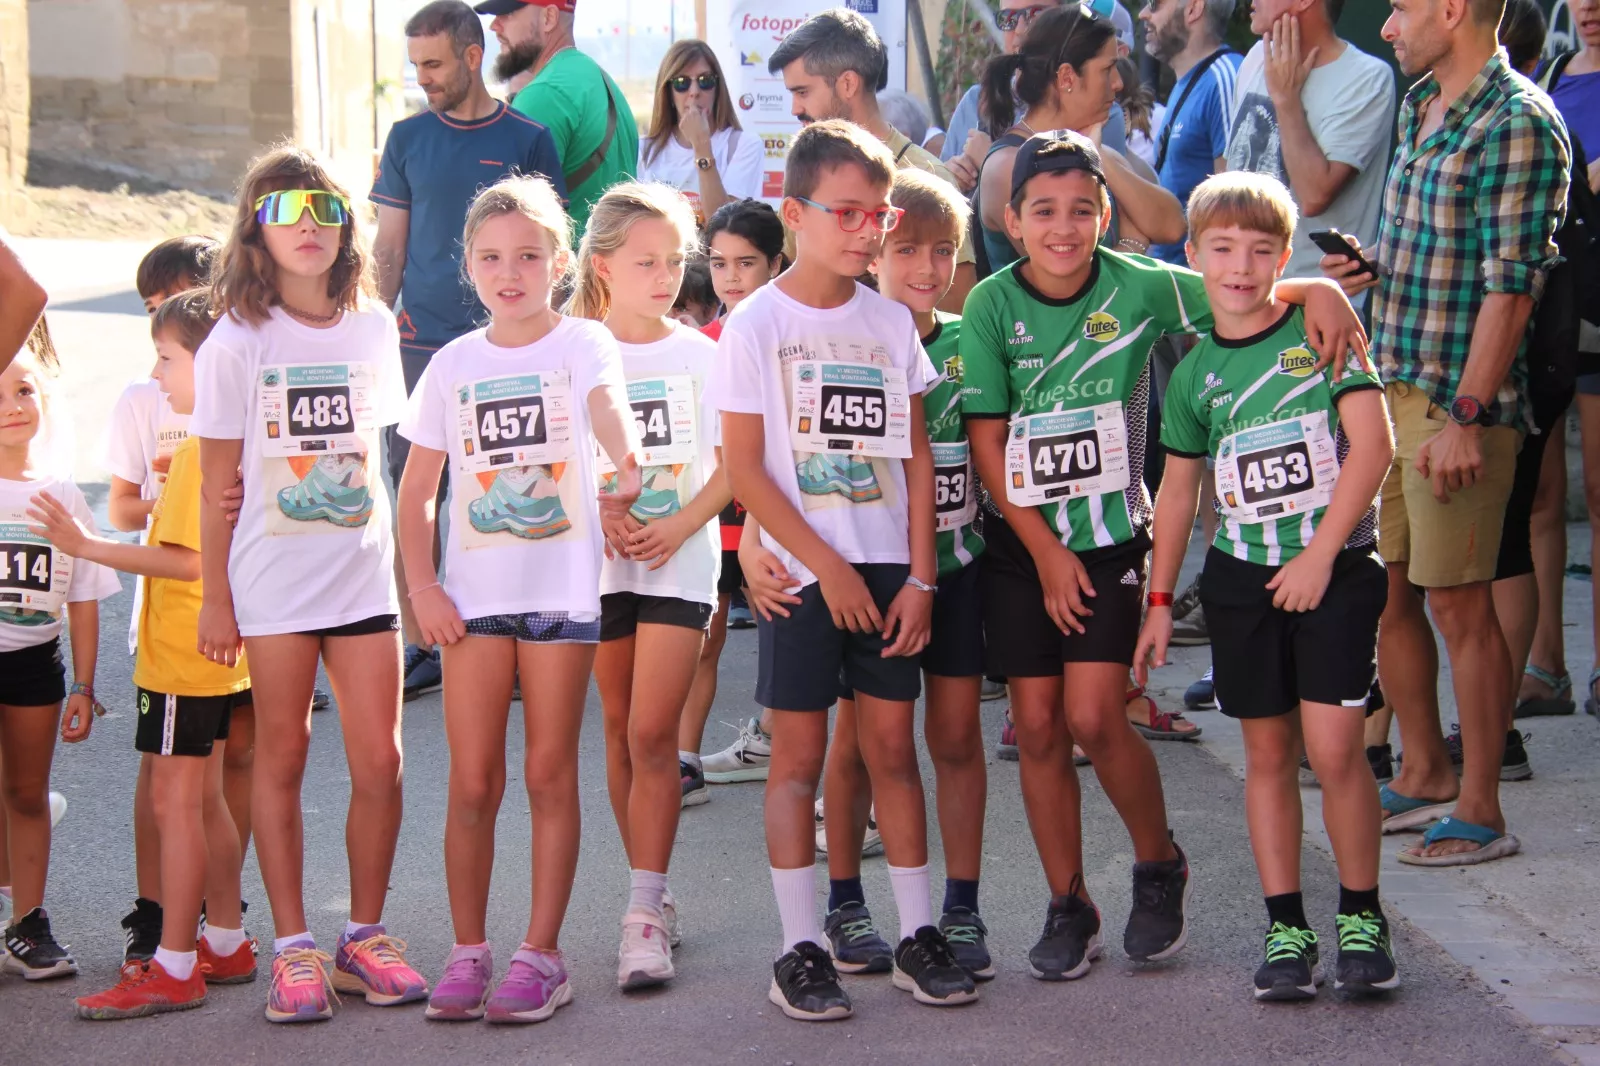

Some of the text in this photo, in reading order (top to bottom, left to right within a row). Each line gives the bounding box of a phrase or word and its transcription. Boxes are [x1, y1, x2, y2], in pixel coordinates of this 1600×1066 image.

[757, 93, 783, 105] feyma
[291, 394, 350, 428] 483
[1020, 378, 1114, 410] Huesca
[480, 404, 541, 442] 457
[824, 394, 883, 429] 455
[1218, 406, 1307, 438] Huesca
[1034, 439, 1097, 477] 470
[1244, 451, 1309, 494] 453
[934, 472, 966, 506] 63
[0, 551, 49, 584] 414
